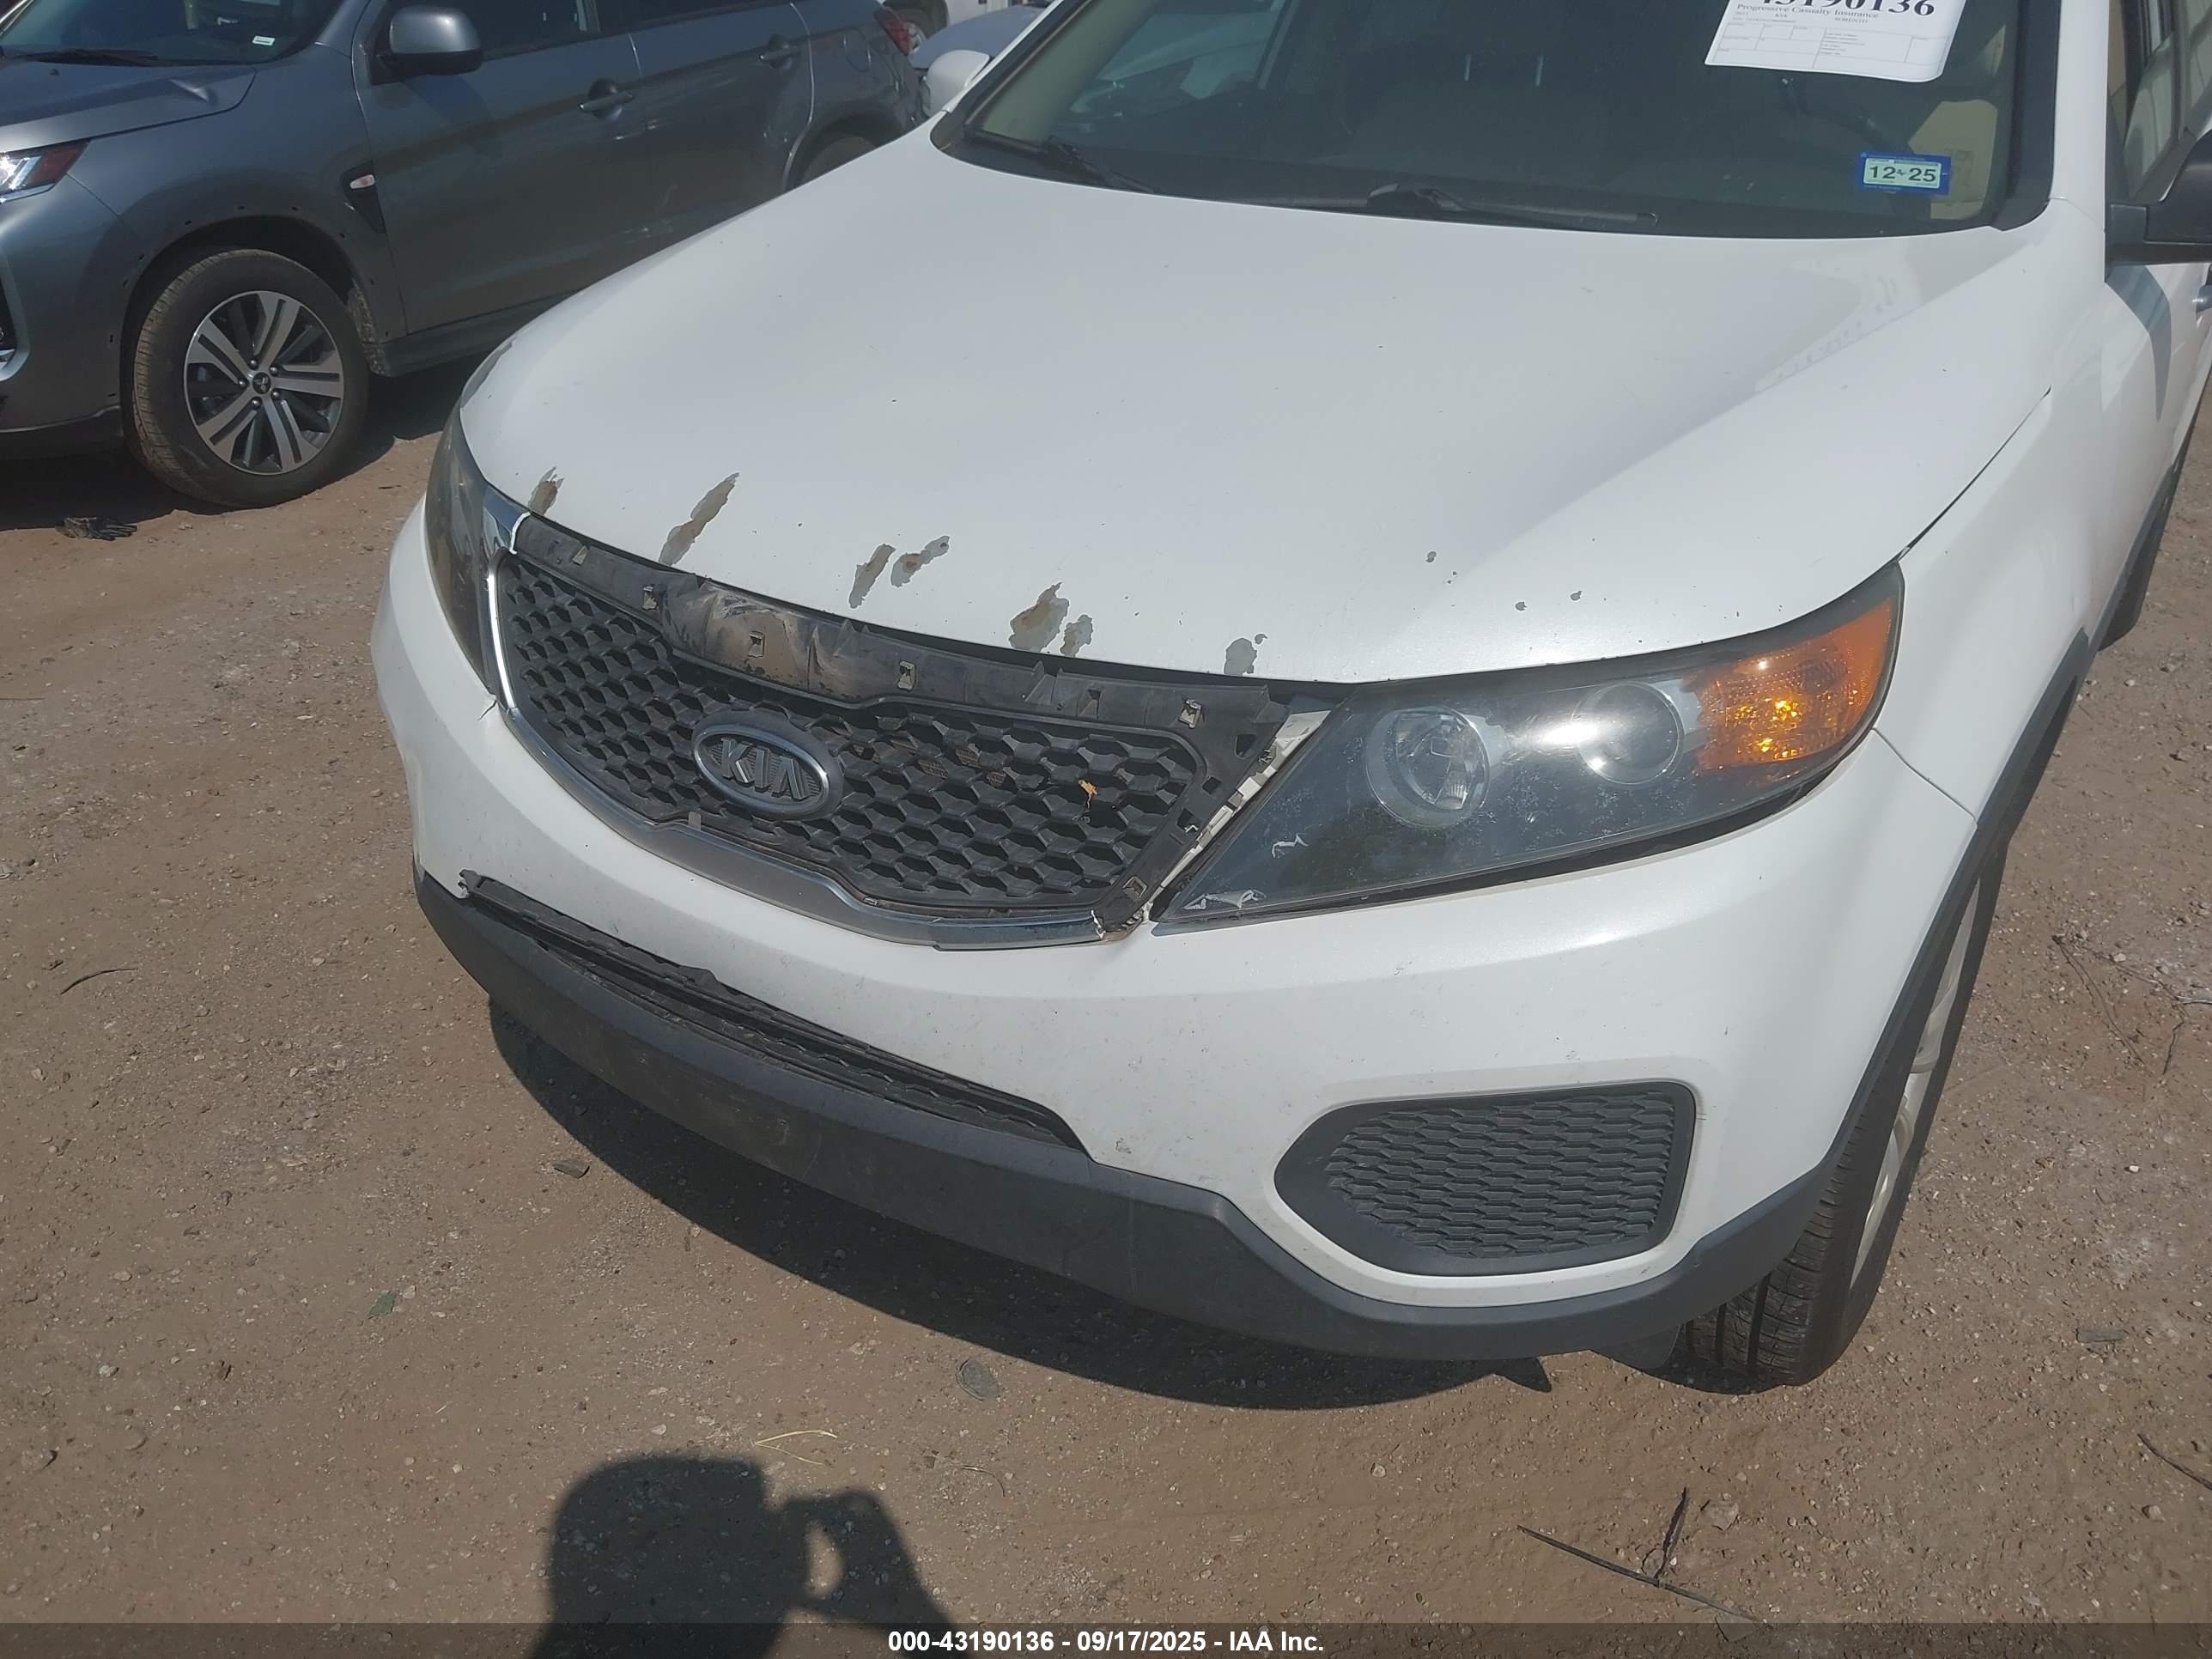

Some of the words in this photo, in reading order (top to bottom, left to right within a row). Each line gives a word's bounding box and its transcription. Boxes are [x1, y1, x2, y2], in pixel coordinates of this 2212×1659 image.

[1736, 3, 1790, 13] Progressive
[1791, 6, 1831, 15] Casualty
[1834, 9, 1879, 19] Insurance
[1763, 0, 1935, 15] 0136
[721, 737, 809, 801] KIA
